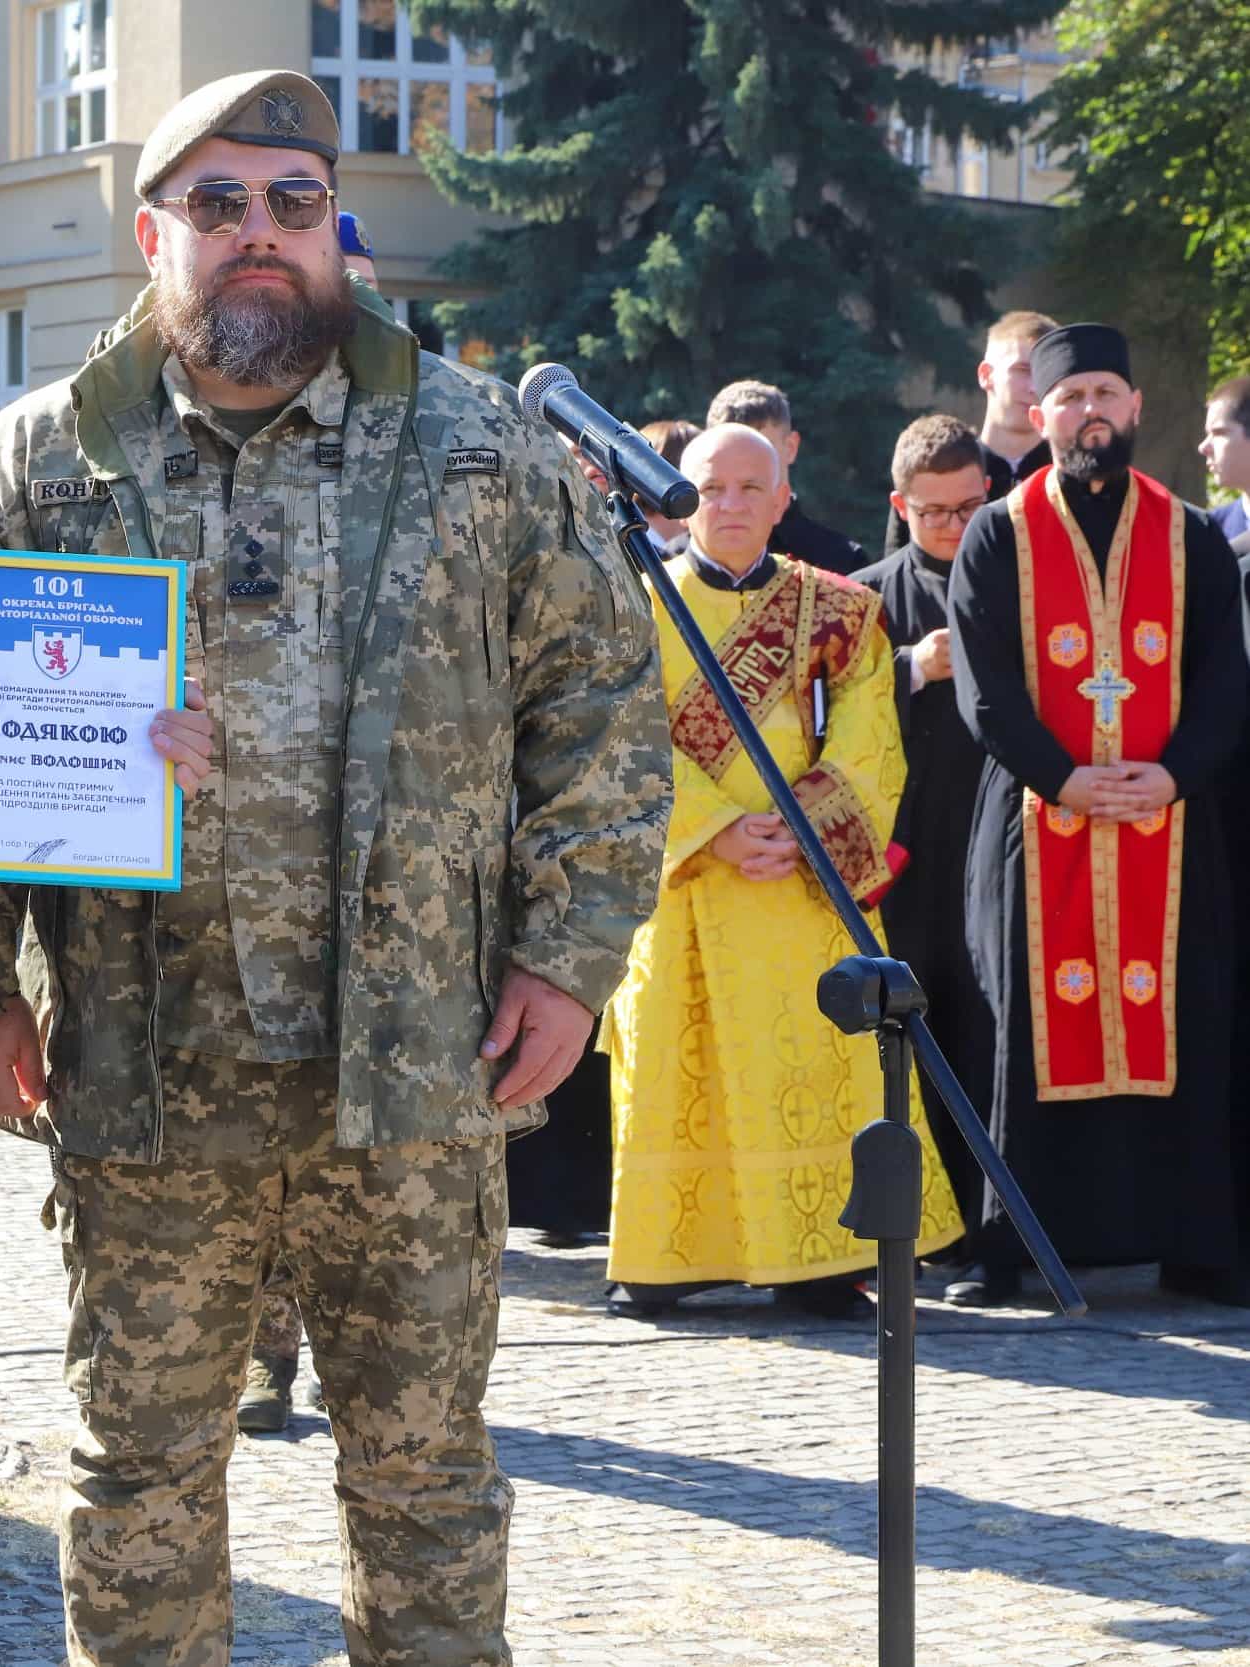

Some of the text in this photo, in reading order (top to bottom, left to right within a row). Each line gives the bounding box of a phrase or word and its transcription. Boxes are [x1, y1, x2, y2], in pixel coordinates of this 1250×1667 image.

[32, 575, 84, 598] 101
[1, 598, 115, 613] ОКРЕМА БРИГАДА
[83, 614, 143, 626] ОБОРОНИ
[6, 694, 44, 703] БРИГАДИ
[46, 696, 114, 707] ТЕРИТОРІАЛЬНОЇ
[115, 701, 154, 709] ОБОРОНИ
[79, 690, 127, 699] КОЛЕКТИВУ
[22, 704, 85, 714] ЗАОХОЧУЄТЬСЯ
[31, 753, 126, 770] ВОЛОШИН
[6, 778, 56, 789] ПОСТІЙНУ
[57, 782, 114, 792] ПІДТРИМКУ
[32, 791, 70, 800] ПИТАНЬ
[72, 793, 146, 805] ЗАБЕЗПЕЧЕННЯ
[61, 803, 106, 813] БРИГАДИ
